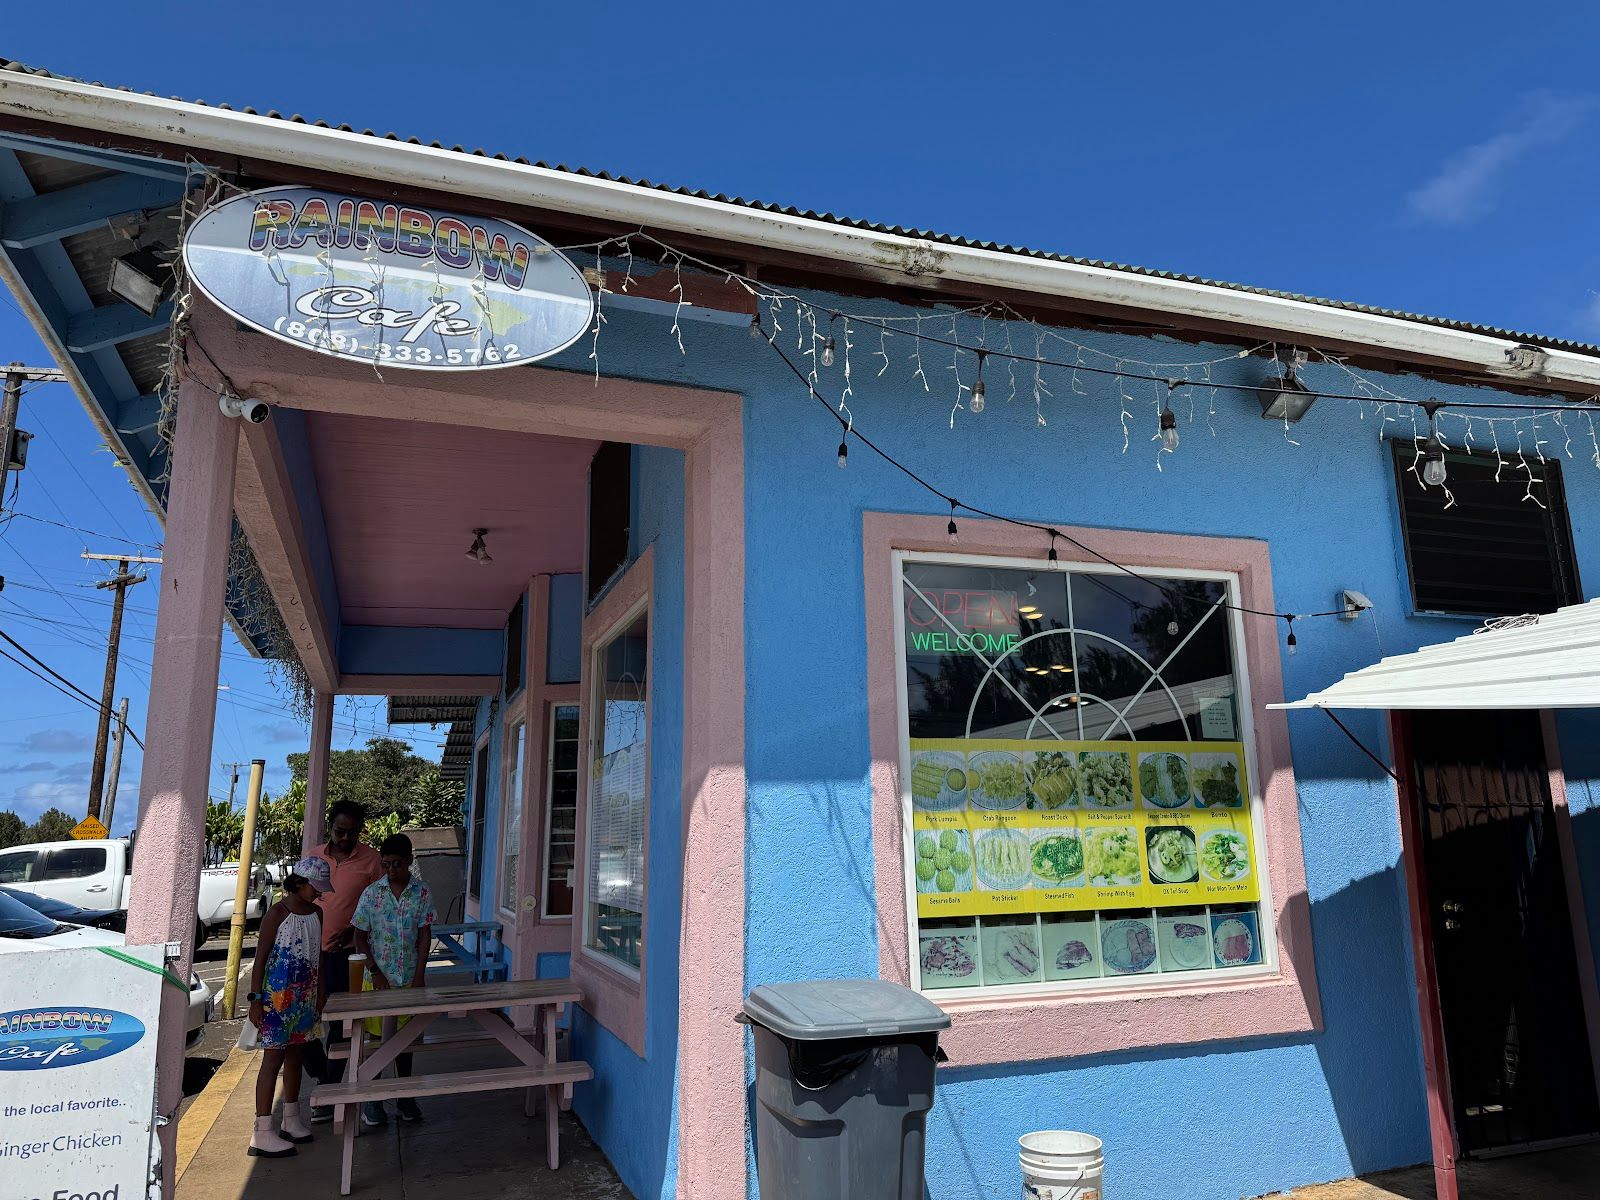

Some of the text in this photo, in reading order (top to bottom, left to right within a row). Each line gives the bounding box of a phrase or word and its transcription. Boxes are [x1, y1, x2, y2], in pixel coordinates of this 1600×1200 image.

[248, 197, 531, 291] RAINBOW
[295, 285, 482, 344] Cafe
[273, 315, 522, 364] (808) 333-5762
[908, 591, 1016, 629] OPEN
[911, 631, 1020, 653] WELCOME
[4, 1105, 26, 1117] the
[30, 1101, 64, 1115] local
[0, 1132, 122, 1160] inger Chicken
